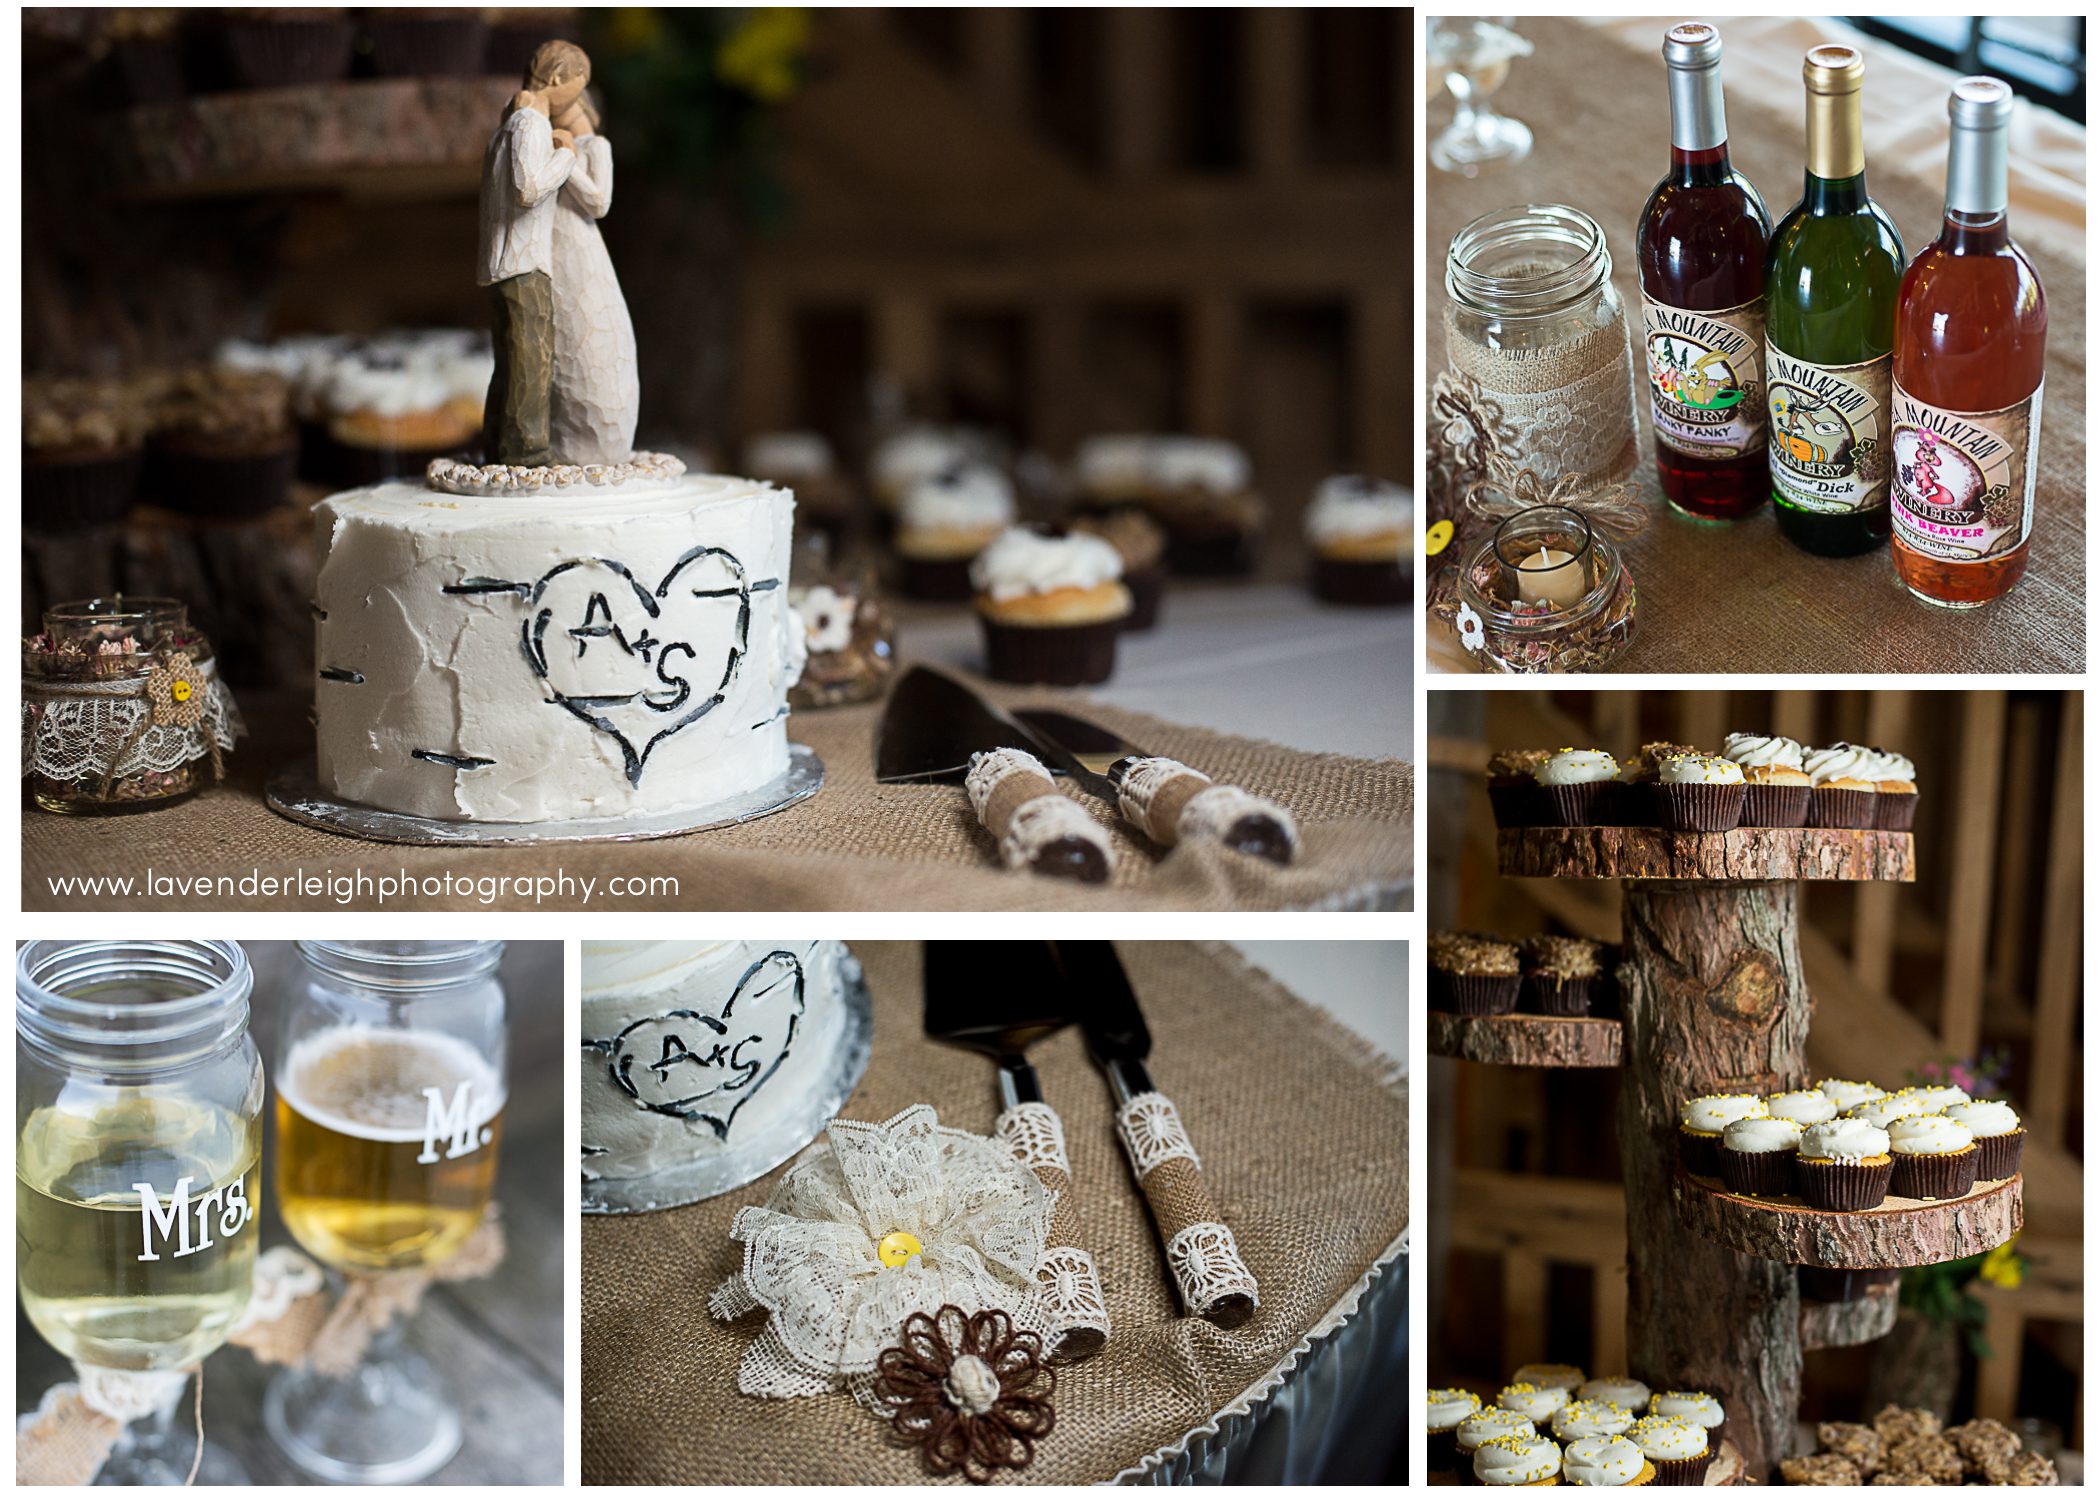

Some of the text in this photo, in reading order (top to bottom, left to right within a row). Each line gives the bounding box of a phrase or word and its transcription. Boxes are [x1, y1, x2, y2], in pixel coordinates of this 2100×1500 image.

[1656, 309, 1748, 356] MOUNTAIN
[1653, 390, 1730, 423] WINERY
[1777, 358, 1869, 414] MOUNTAIN
[1686, 424, 1731, 437] PANKY
[1905, 401, 2003, 460] MOUNTAIN
[1771, 437, 1846, 477] WINERY
[1817, 482, 1855, 493] Dick
[1892, 479, 1974, 524] WINERY
[1918, 518, 1984, 538] BEAVER
[1947, 536, 1965, 544] Wine
[416, 1081, 493, 1164] Mr.
[132, 1173, 254, 1262] Mrs.
